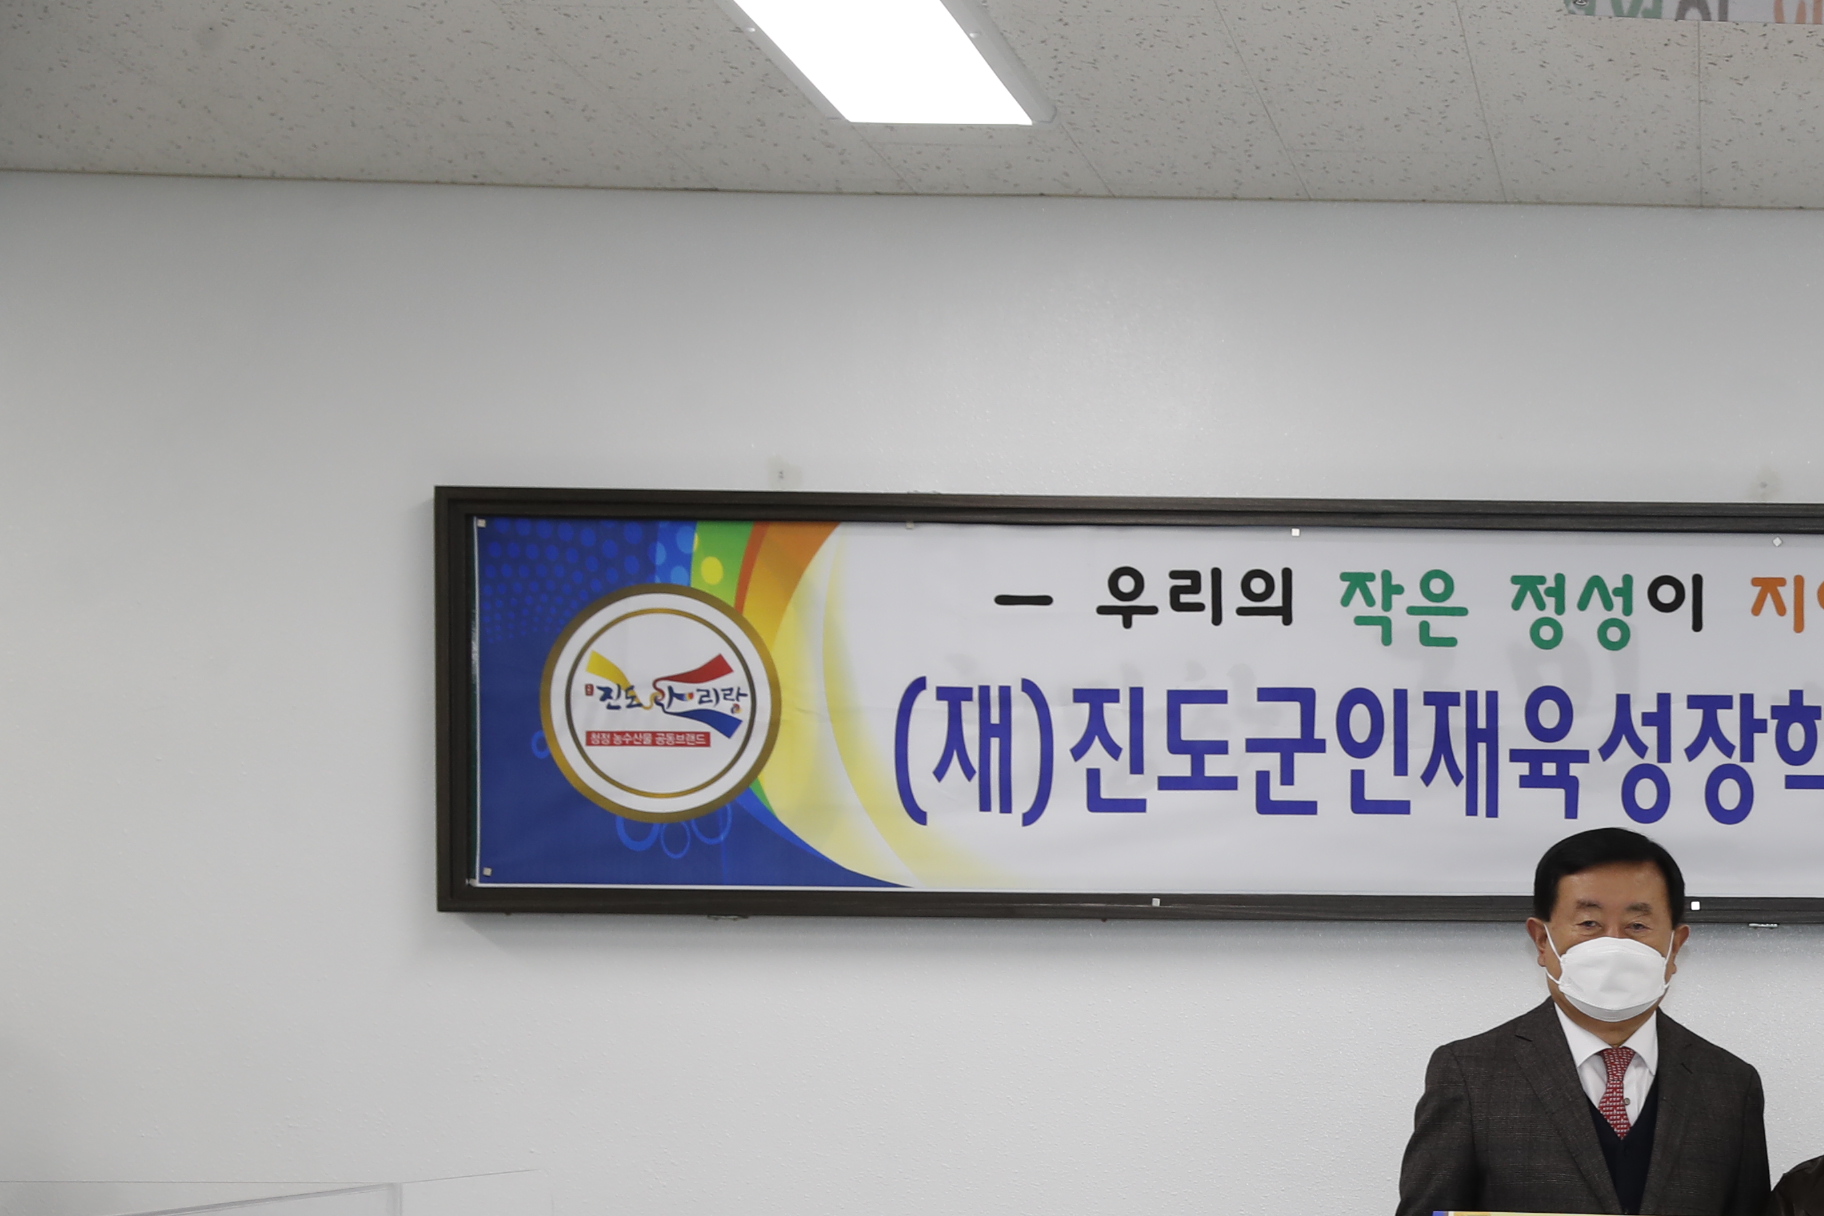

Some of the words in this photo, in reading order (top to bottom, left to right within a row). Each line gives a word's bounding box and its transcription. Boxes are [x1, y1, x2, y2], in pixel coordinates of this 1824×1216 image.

[1096, 566, 1293, 628] 우리의
[1339, 569, 1469, 648] 작은
[1510, 572, 1704, 651] 정성이
[655, 733, 706, 746] 공동브랜드
